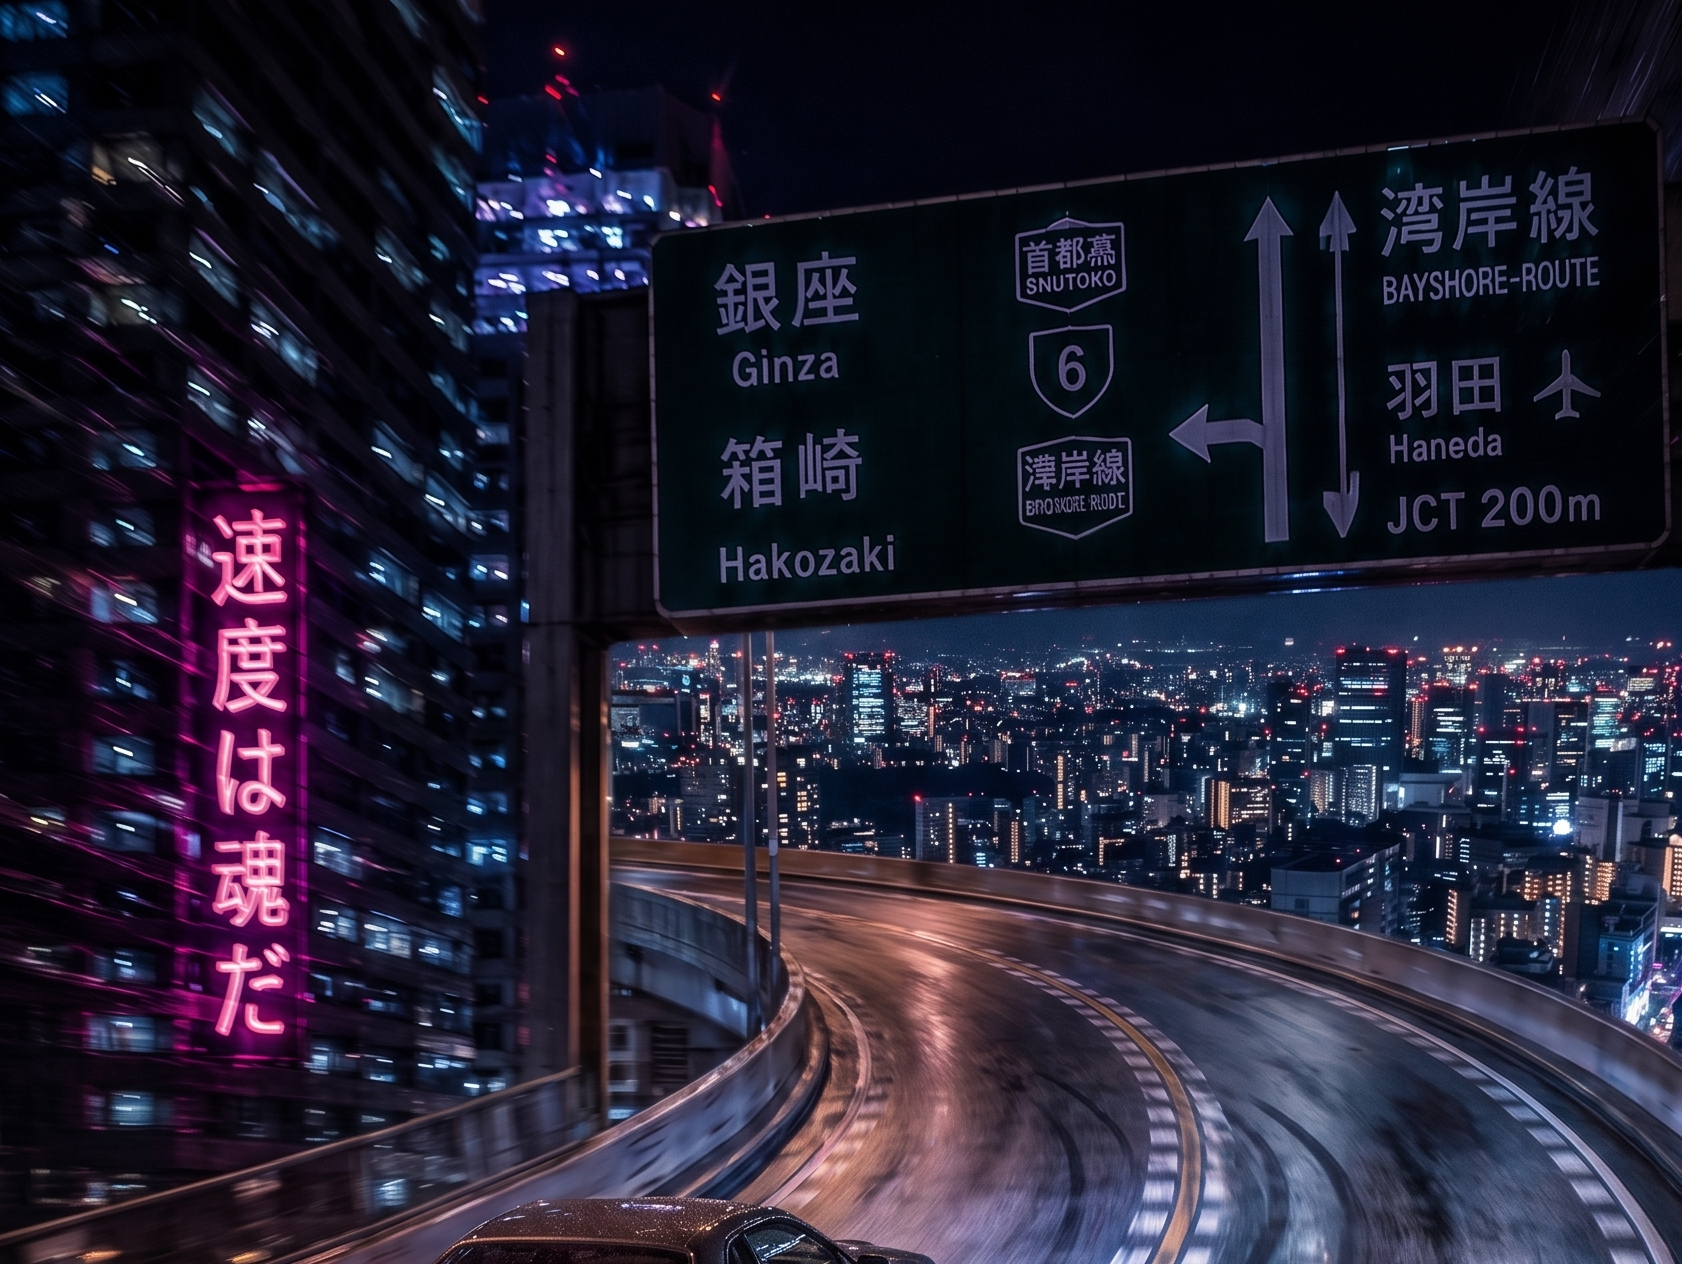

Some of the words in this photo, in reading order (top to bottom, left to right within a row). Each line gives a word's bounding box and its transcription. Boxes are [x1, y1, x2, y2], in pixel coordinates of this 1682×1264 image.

[1381, 167, 1599, 257] 湾岸線
[714, 251, 860, 336] 銀座
[1026, 269, 1117, 295] SNUTOKO
[1382, 256, 1600, 305] BAYSHORE-ROUTE
[732, 350, 840, 388] Ginza
[1058, 345, 1087, 392] 6
[1387, 357, 1502, 421] 羽田
[721, 429, 863, 510] 箱崎
[1390, 427, 1503, 464] Haneda
[1388, 492, 1465, 535] JCT
[1482, 485, 1601, 528] 200m
[720, 535, 895, 585] Hakozaki
[211, 508, 290, 1037] 速度は魂だ
